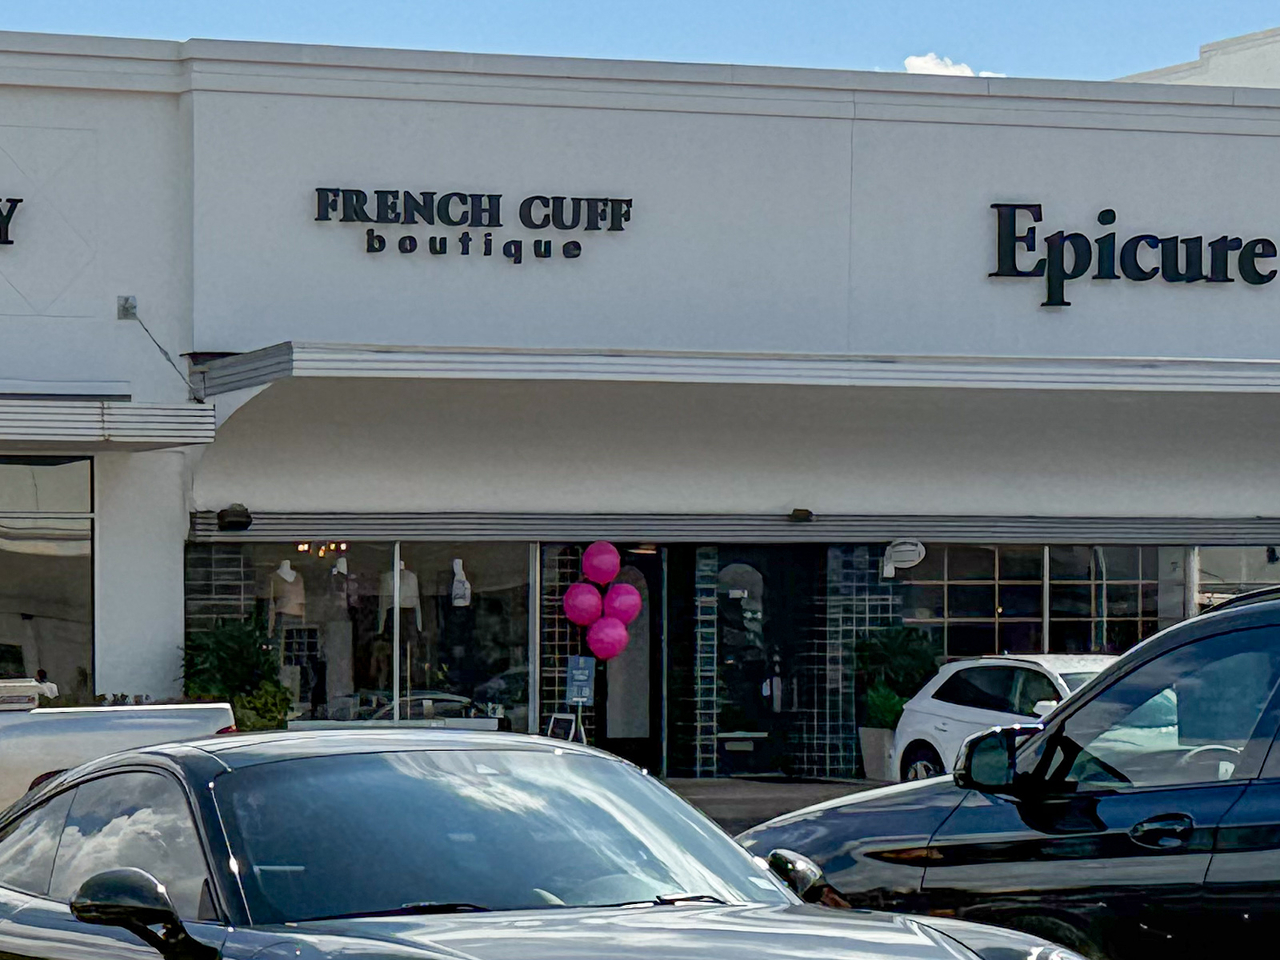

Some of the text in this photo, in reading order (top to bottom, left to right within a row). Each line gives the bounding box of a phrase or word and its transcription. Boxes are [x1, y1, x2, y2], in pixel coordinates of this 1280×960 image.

[314, 187, 633, 232] FRENCH CUFF
[365, 228, 583, 265] boutique
[987, 203, 1278, 308] Epicure
